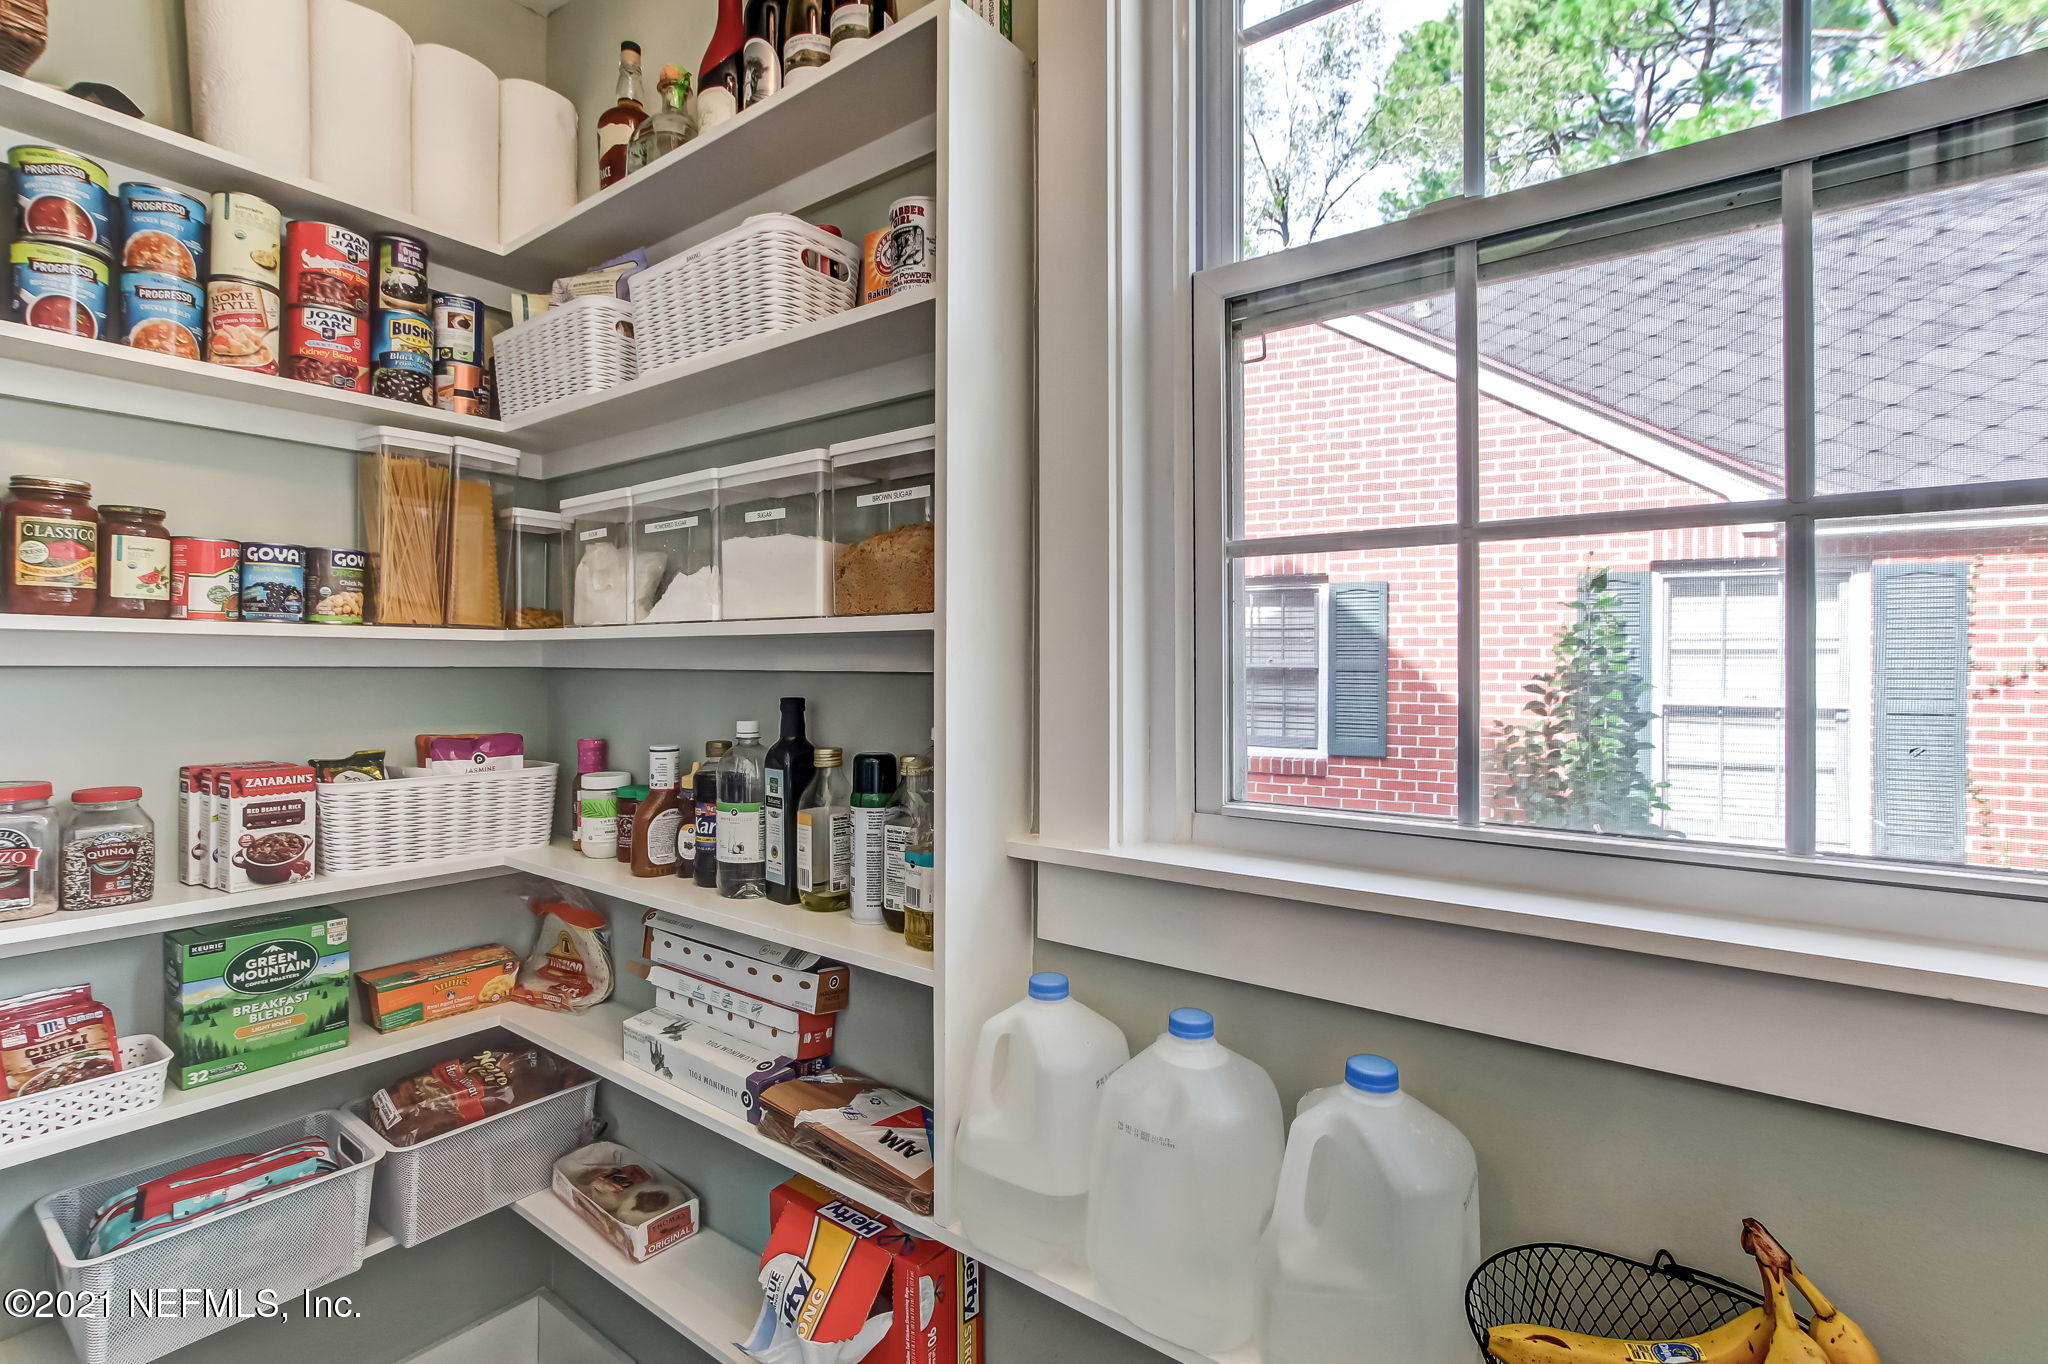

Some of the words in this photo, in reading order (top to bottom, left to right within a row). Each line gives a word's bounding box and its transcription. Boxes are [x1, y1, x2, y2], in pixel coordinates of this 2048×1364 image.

[24, 164, 87, 180] PROGRESSO
[131, 200, 186, 216] PROGRESSO
[331, 230, 369, 250] JOAN
[344, 242, 368, 258] ARC
[32, 261, 94, 278] PROGRESSO
[323, 267, 354, 282] Kidney
[899, 272, 932, 280] POWDER
[139, 289, 192, 303] PROGRESSO
[211, 292, 255, 305] HOME
[212, 301, 257, 313] STYLE
[306, 310, 352, 325] JOAN
[318, 321, 353, 332] ARC
[392, 321, 434, 344] BUSH'S
[299, 346, 330, 359] Kidney
[333, 350, 358, 363] Beans
[390, 352, 415, 362] Black
[871, 493, 893, 503] BROWN
[892, 489, 913, 500] SUGAR
[756, 511, 773, 519] SUGAR
[23, 523, 95, 542] CLASSICO
[247, 546, 299, 563] GOYA
[464, 765, 497, 774] JASMINE
[245, 773, 315, 788] ZATARAIN'S
[696, 816, 717, 834] Kar
[0, 851, 27, 864] ZO
[87, 848, 135, 860] QUINOA
[191, 942, 224, 953] KEURIG
[245, 950, 298, 970] GREEN
[232, 959, 311, 984] MOUNTAIN
[244, 979, 269, 988] COFFEE
[269, 973, 300, 983] ROASTERS
[232, 991, 310, 1017] BREAKFAST
[249, 1005, 295, 1024] BLEND
[24, 1033, 89, 1058] CHILI
[721, 1044, 759, 1064] ALUMINUM
[187, 1069, 209, 1086] 32
[688, 1068, 702, 1082] FOIL
[703, 1076, 738, 1098] ALUMINUM
[878, 1128, 924, 1159] AJM
[825, 1200, 882, 1237] Hefty
[648, 1227, 690, 1254] ORIGINAL
[767, 1270, 782, 1307] LUE
[963, 1256, 979, 1314] efty
[780, 1272, 811, 1329] fty
[798, 1288, 825, 1337] ONG
[961, 1325, 973, 1364] STRO
